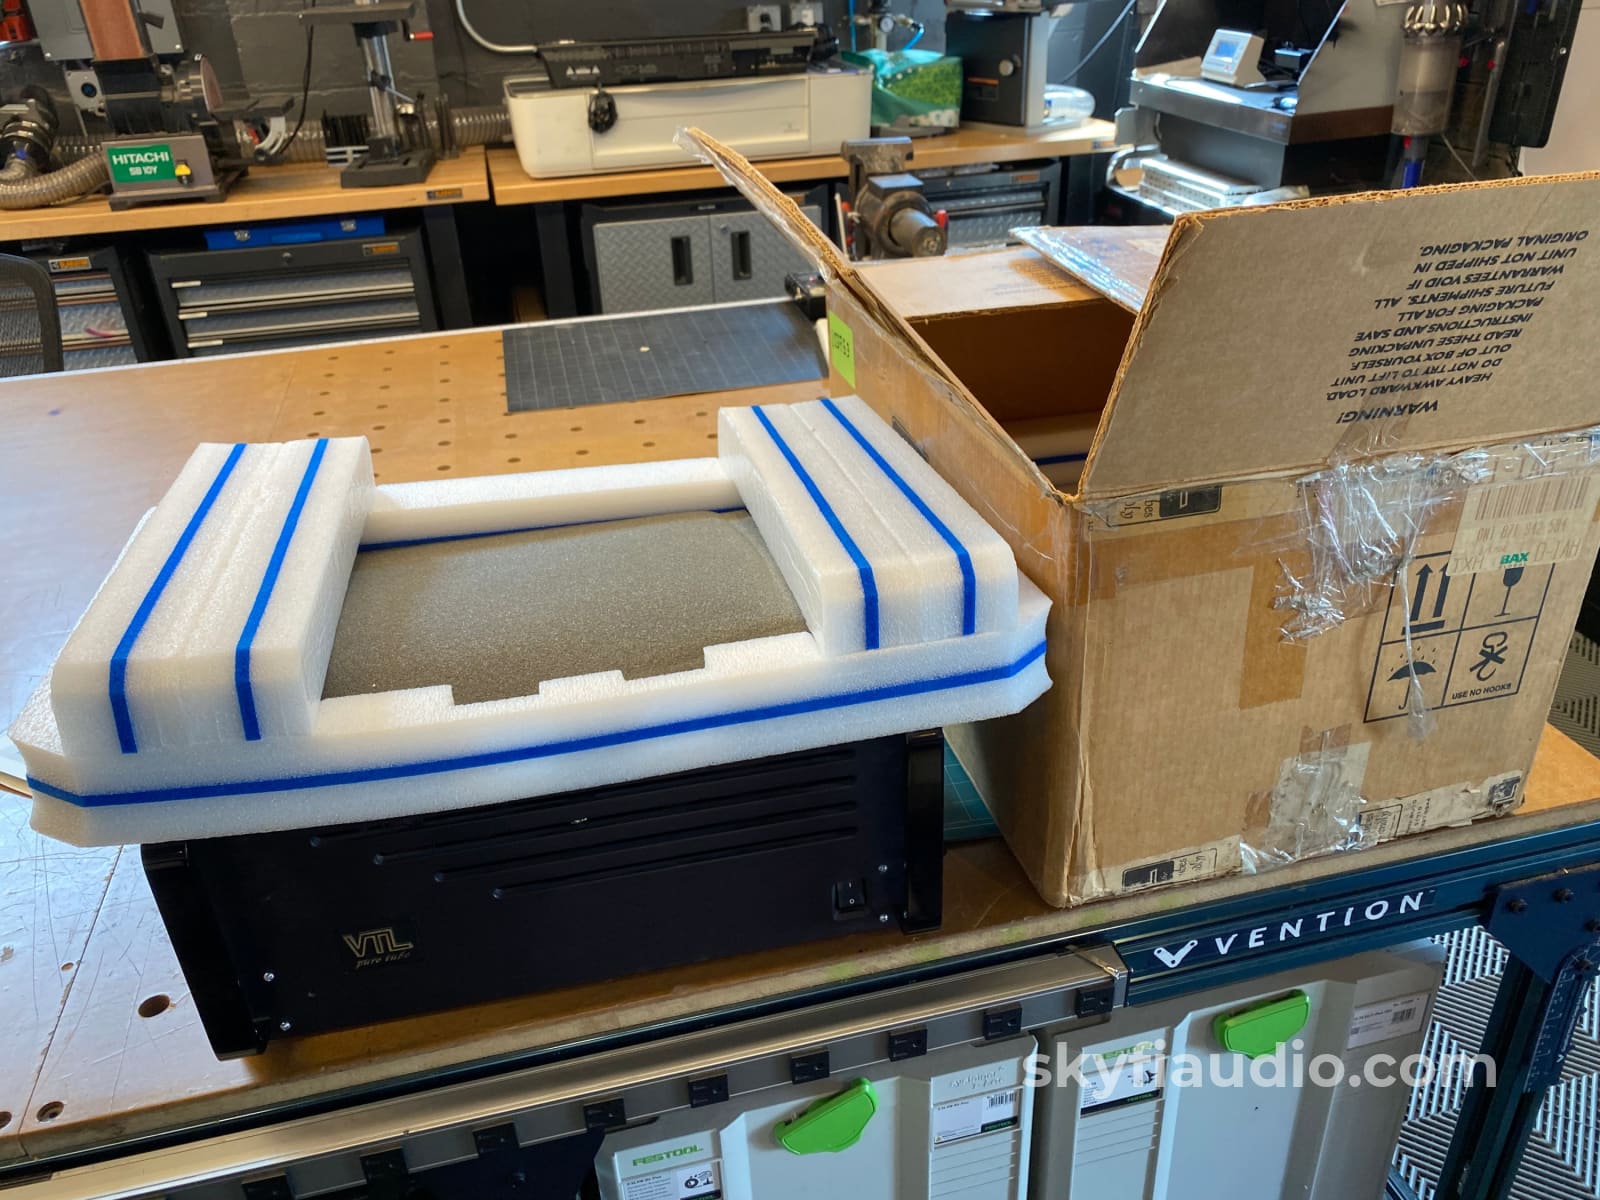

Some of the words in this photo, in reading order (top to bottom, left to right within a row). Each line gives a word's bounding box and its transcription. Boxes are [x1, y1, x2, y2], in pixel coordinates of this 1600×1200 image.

[112, 151, 170, 165] HITACHI
[1517, 230, 1589, 247] ORIGINAL
[1420, 236, 1513, 257] PACKAGING.
[1501, 251, 1537, 264] NOT
[1538, 247, 1577, 260] UNIT
[1414, 262, 1432, 274] IN
[1435, 255, 1500, 271] SHIPPED
[1463, 264, 1565, 284] WARRANTEES
[1407, 279, 1423, 290] IF
[1425, 275, 1461, 288] VOID
[1495, 280, 1556, 296] FUTURE
[1374, 296, 1402, 309] ALL
[1458, 296, 1545, 315] PACKAGING
[1397, 310, 1426, 322] ALL
[1425, 306, 1456, 319] FOR
[1427, 313, 1533, 333] INSTRUCTIONS
[1354, 328, 1392, 342] SAVE
[1393, 325, 1428, 337] AND
[1483, 328, 1523, 341] READ
[1436, 333, 1481, 346] THESE
[1348, 338, 1434, 357] UNPACKING
[1456, 347, 1478, 358] OF
[1478, 343, 1512, 355] OUT
[1422, 350, 1455, 363] BOX
[1422, 364, 1448, 376] TRY
[1449, 361, 1479, 372] NOT
[1481, 358, 1503, 369] DO
[1368, 370, 1398, 383] LIFT
[1402, 367, 1424, 379] TO
[1446, 372, 1493, 387] HEAVY
[1331, 375, 1365, 387] UNIT
[1370, 376, 1447, 395] AWKWARD
[1327, 388, 1366, 401] LOAD.
[1336, 400, 1440, 424] WARNING!
[1500, 552, 1529, 565] BAX
[1452, 691, 1467, 700] USE
[1469, 688, 1482, 697] NO
[1483, 682, 1512, 695] HOOKS
[1214, 891, 1424, 955] VENTION
[342, 927, 414, 957] VTL
[632, 1144, 698, 1167] FESTOOL
